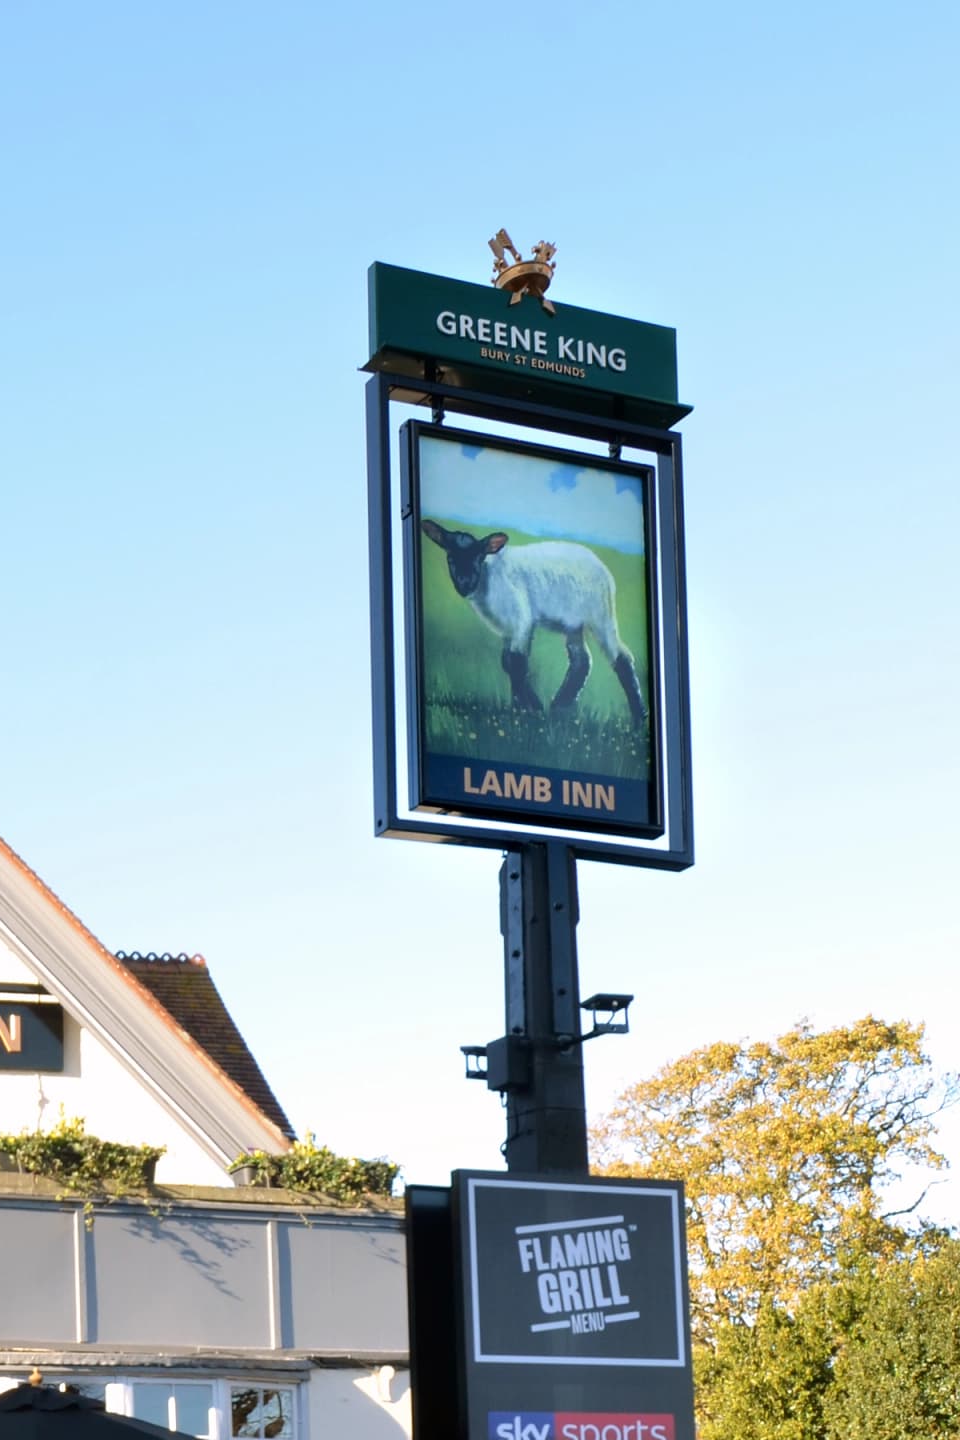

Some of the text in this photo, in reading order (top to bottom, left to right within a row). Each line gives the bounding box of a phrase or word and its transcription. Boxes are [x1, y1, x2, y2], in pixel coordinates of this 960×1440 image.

[436, 310, 628, 372] GREENE KING
[480, 347, 586, 378] BURY ST EDMUNDS
[463, 767, 616, 811] LAMB INN
[517, 1228, 632, 1273] FLAMING
[537, 1265, 630, 1314] GRILL
[570, 1311, 605, 1334] MENU
